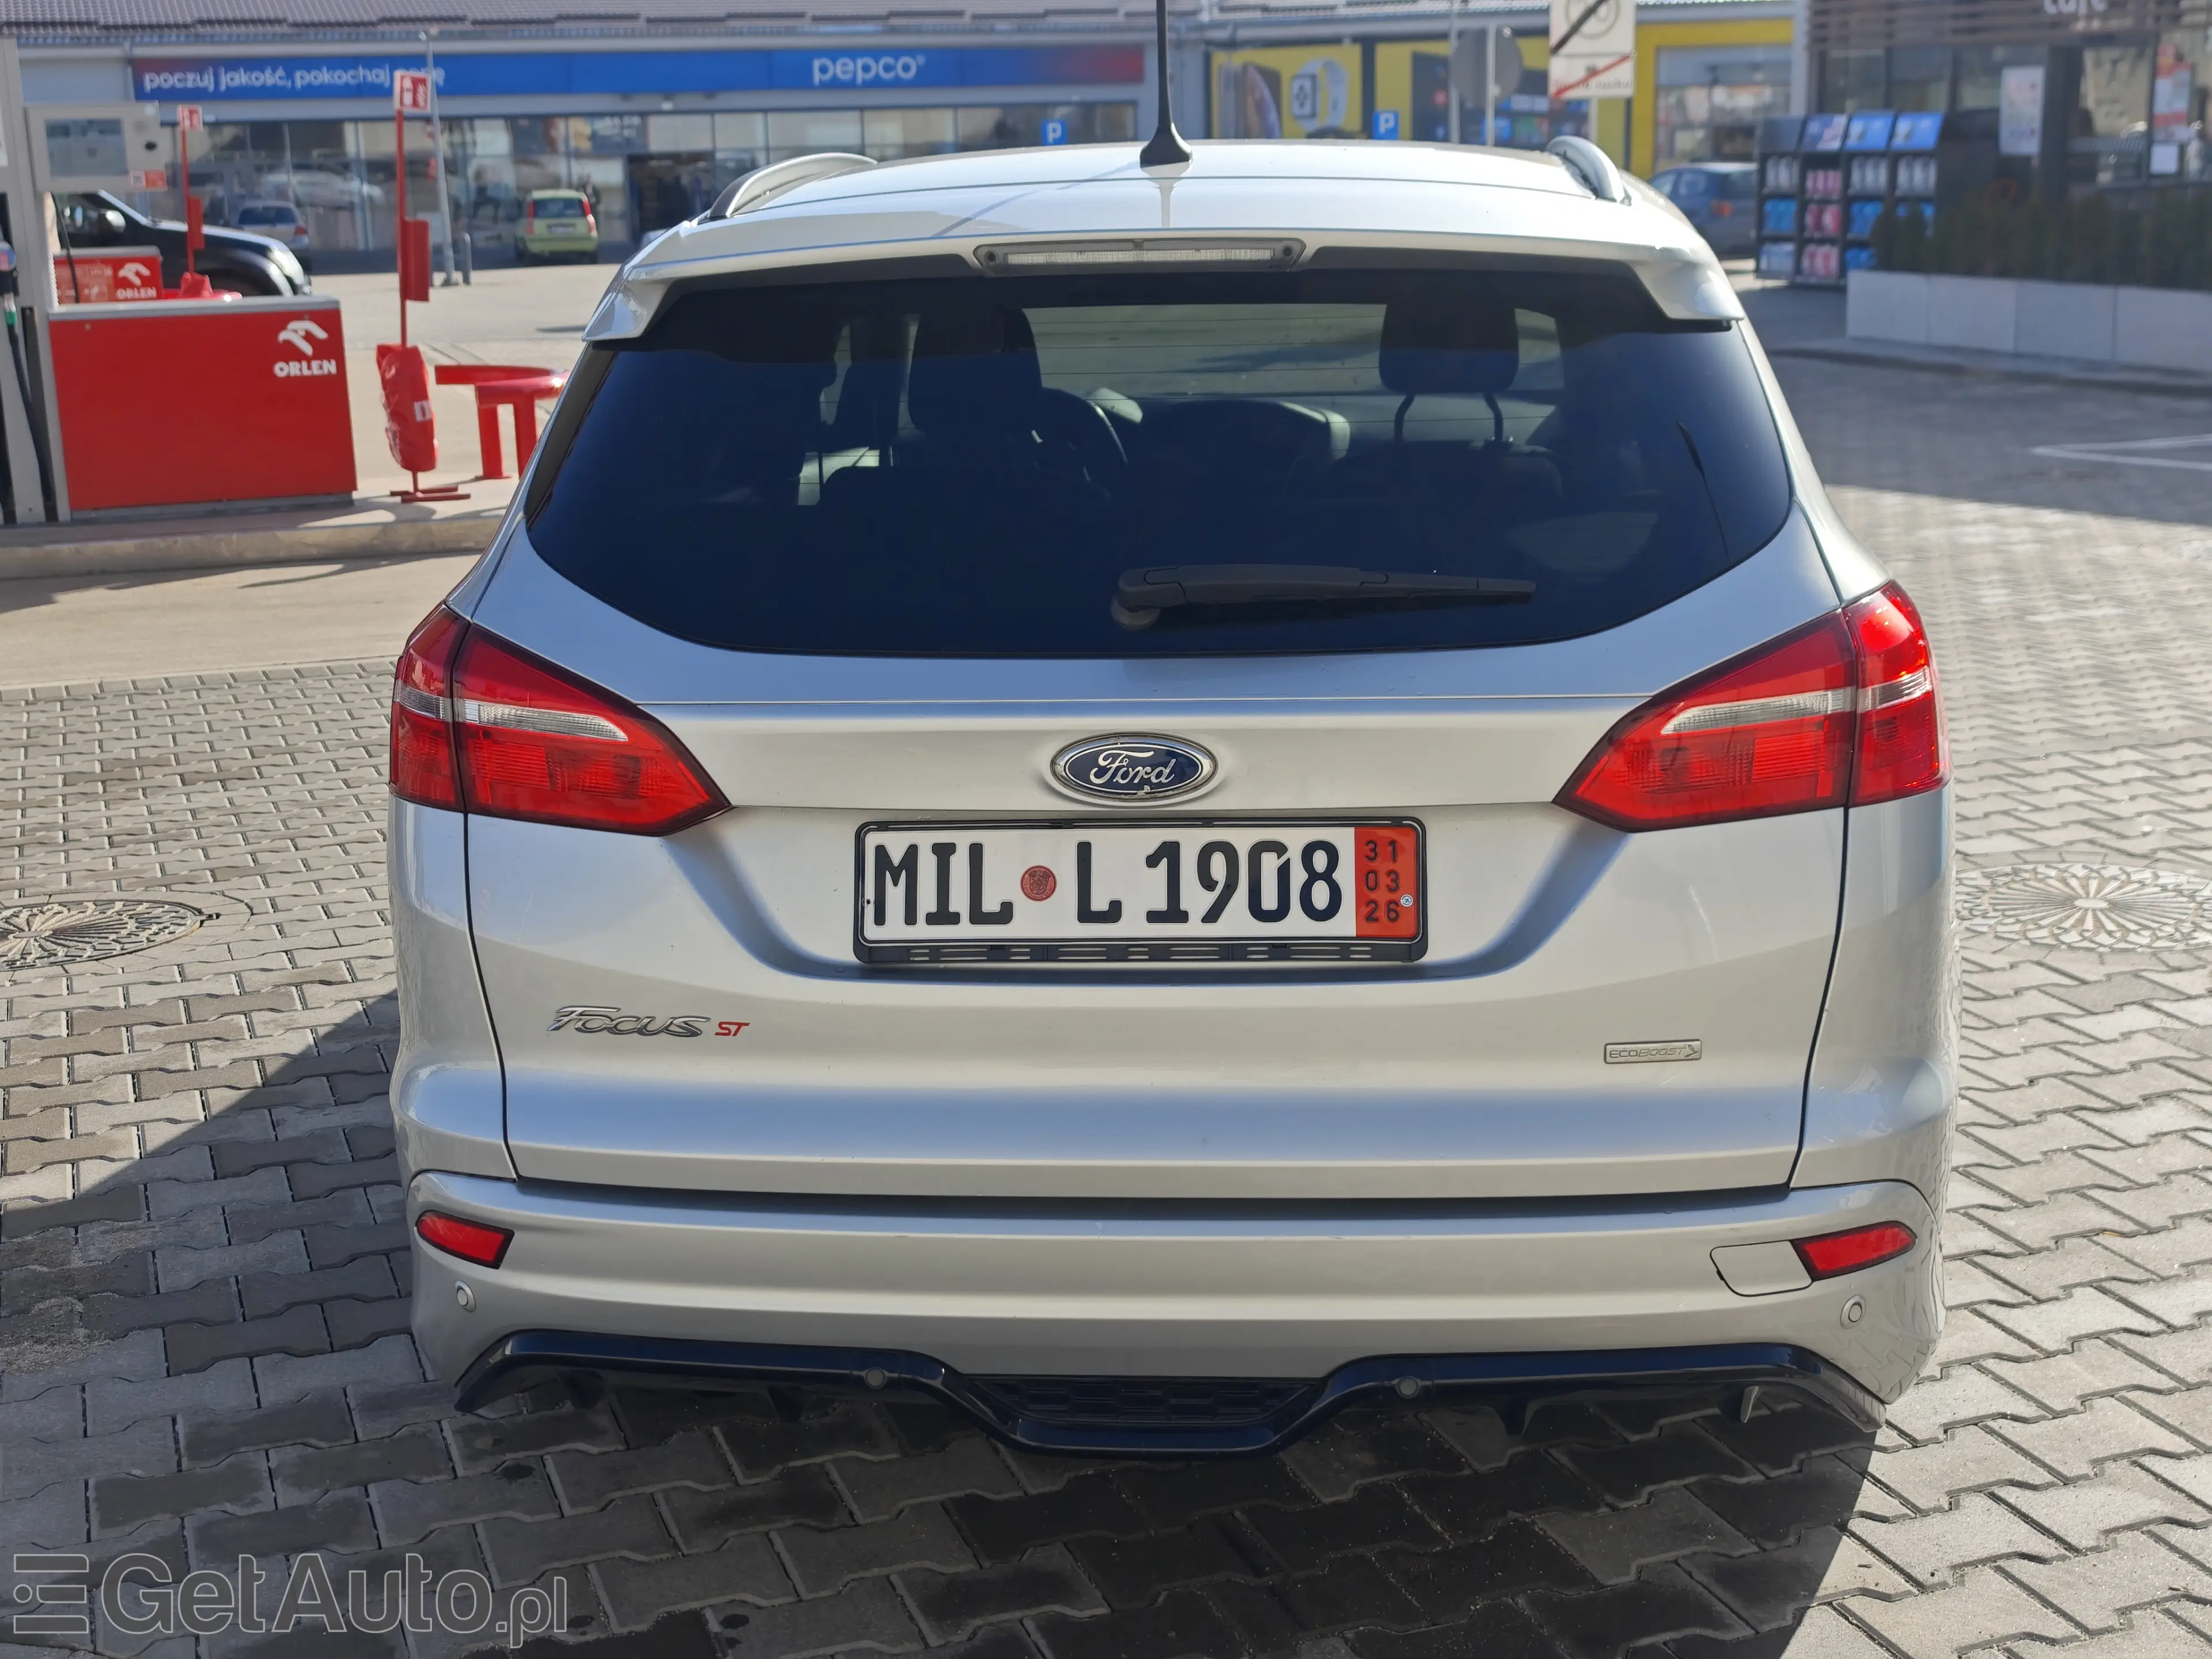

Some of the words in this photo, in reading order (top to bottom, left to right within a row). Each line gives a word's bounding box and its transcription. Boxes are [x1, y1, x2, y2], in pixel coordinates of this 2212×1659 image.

[144, 66, 214, 93] poczuj
[218, 65, 291, 92] jakość,
[295, 64, 390, 90] pokochaj
[1047, 122, 1062, 143] P
[1379, 113, 1395, 134] P
[116, 286, 157, 300] ORLEN
[273, 358, 337, 378] ORLEN
[1090, 749, 1176, 784] Ford
[874, 842, 1014, 926] MIL
[1077, 841, 1122, 923] L
[1145, 840, 1342, 923] 1908
[715, 1021, 750, 1036] ST
